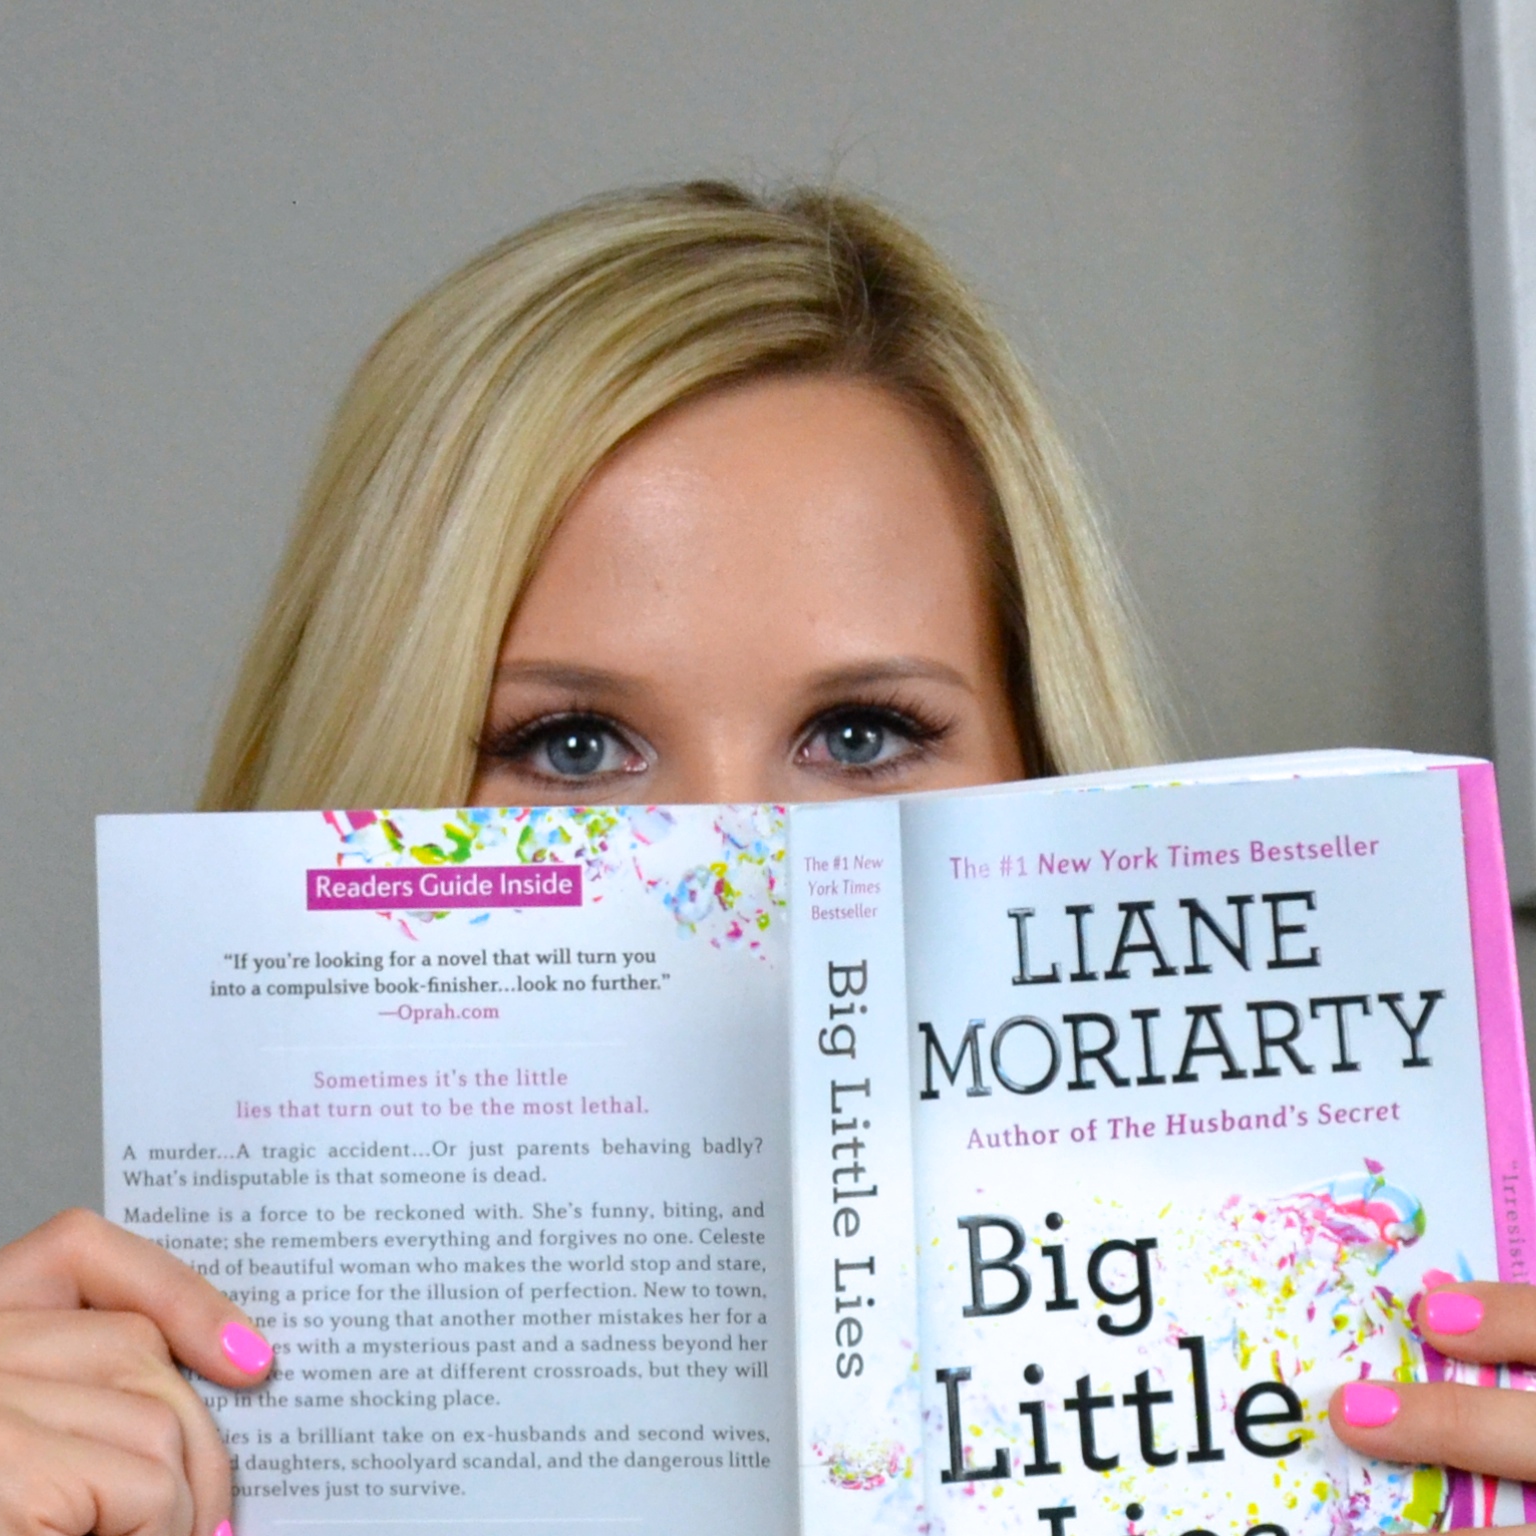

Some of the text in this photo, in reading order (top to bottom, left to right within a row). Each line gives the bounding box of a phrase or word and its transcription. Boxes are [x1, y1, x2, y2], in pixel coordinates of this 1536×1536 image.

[805, 855, 884, 872] The #1 New
[950, 835, 1380, 880] The #1 New York Times Bestseller
[315, 871, 573, 899] Readers Guide Inside
[808, 879, 881, 896] York Times
[810, 903, 878, 919] Bestseller
[314, 950, 385, 973] looking
[388, 949, 417, 968] for
[420, 954, 433, 968] a
[436, 948, 488, 967] novel
[491, 948, 531, 967] that
[534, 946, 572, 966] will
[575, 950, 618, 965] turn
[621, 951, 657, 969] you
[1007, 890, 1321, 986] LIANE
[917, 990, 1447, 1102] MORIARTY
[313, 1070, 429, 1090] Sometimes
[474, 1068, 509, 1088] the
[516, 1066, 569, 1087] little
[966, 1122, 1060, 1150] Author
[1070, 1118, 1099, 1144] of
[1106, 1114, 1156, 1141] The
[1318, 1099, 1401, 1128] Secret
[192, 1167, 310, 1191] indisputable
[315, 1169, 331, 1185] is
[335, 1167, 374, 1185] that
[379, 1171, 467, 1185] someone
[472, 1167, 488, 1184] is
[493, 1164, 547, 1184] dead.
[819, 960, 880, 1379] Big Little Lies
[1502, 1160, 1529, 1285] "Irresisti
[956, 1211, 1159, 1336] Big
[935, 1335, 1304, 1485] Little
